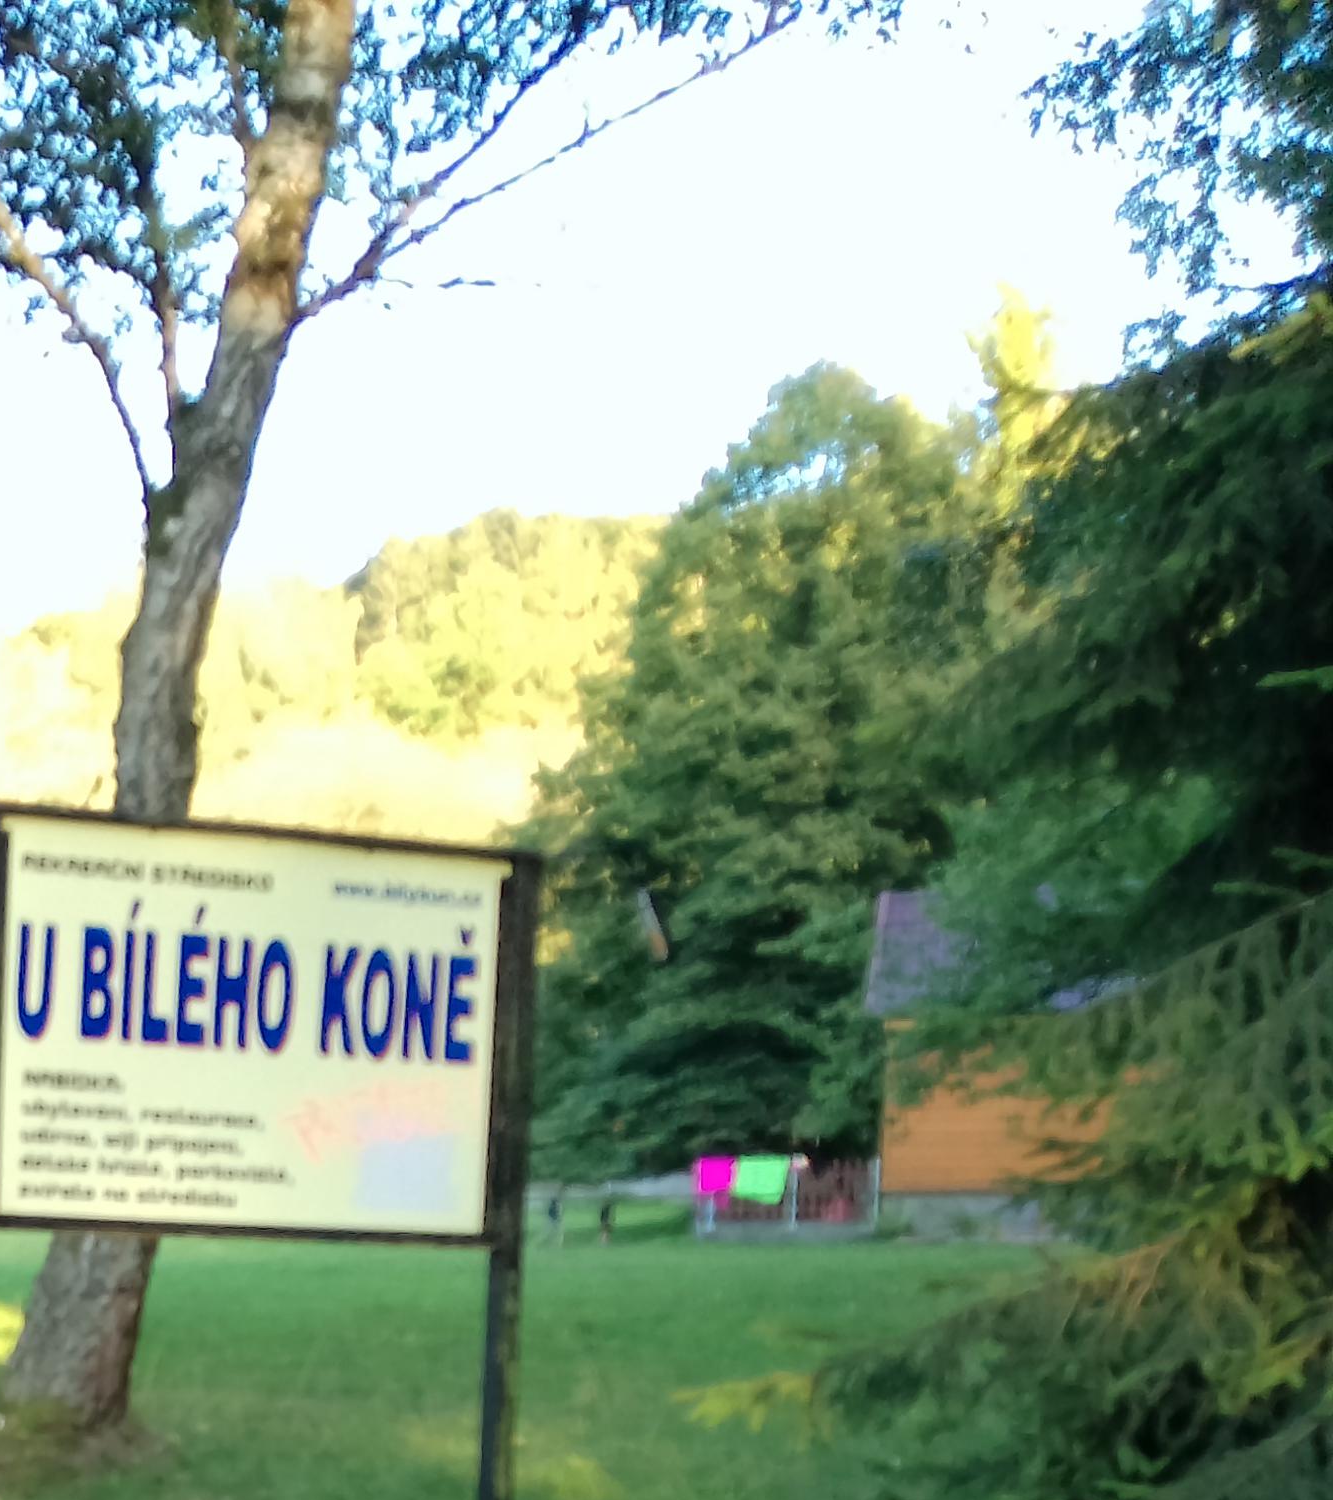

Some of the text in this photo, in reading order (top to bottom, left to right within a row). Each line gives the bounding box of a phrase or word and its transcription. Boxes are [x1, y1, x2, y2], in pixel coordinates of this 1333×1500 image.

[18, 899, 477, 1062] U BÍLÉHO KONĚ
